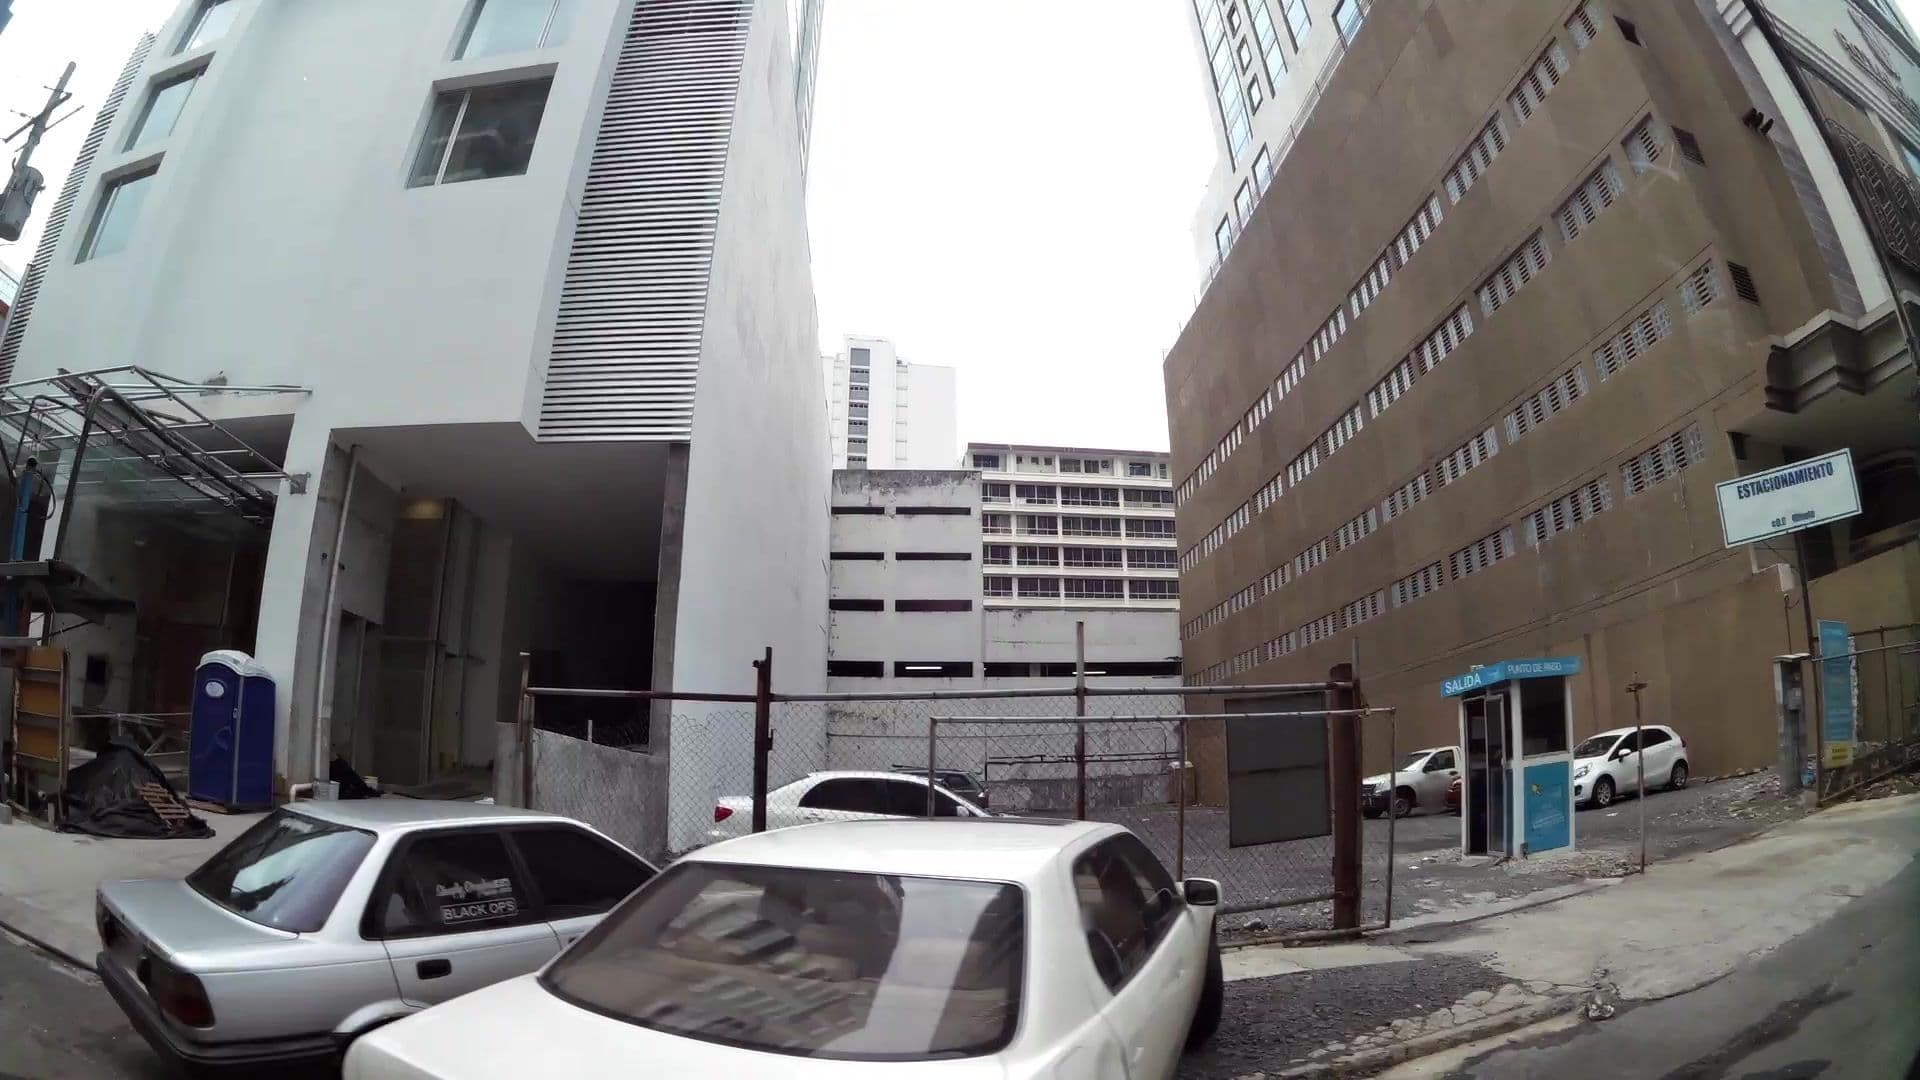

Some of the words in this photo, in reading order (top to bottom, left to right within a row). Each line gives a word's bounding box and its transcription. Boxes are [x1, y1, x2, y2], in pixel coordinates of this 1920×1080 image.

[1737, 462, 1834, 499] ESTACIONAMIENTO
[1507, 663, 1532, 673] PUNTO
[1532, 663, 1543, 672] DE
[1445, 673, 1482, 694] SALIDA
[442, 904, 487, 920] BLACK
[488, 901, 514, 914] OPS
